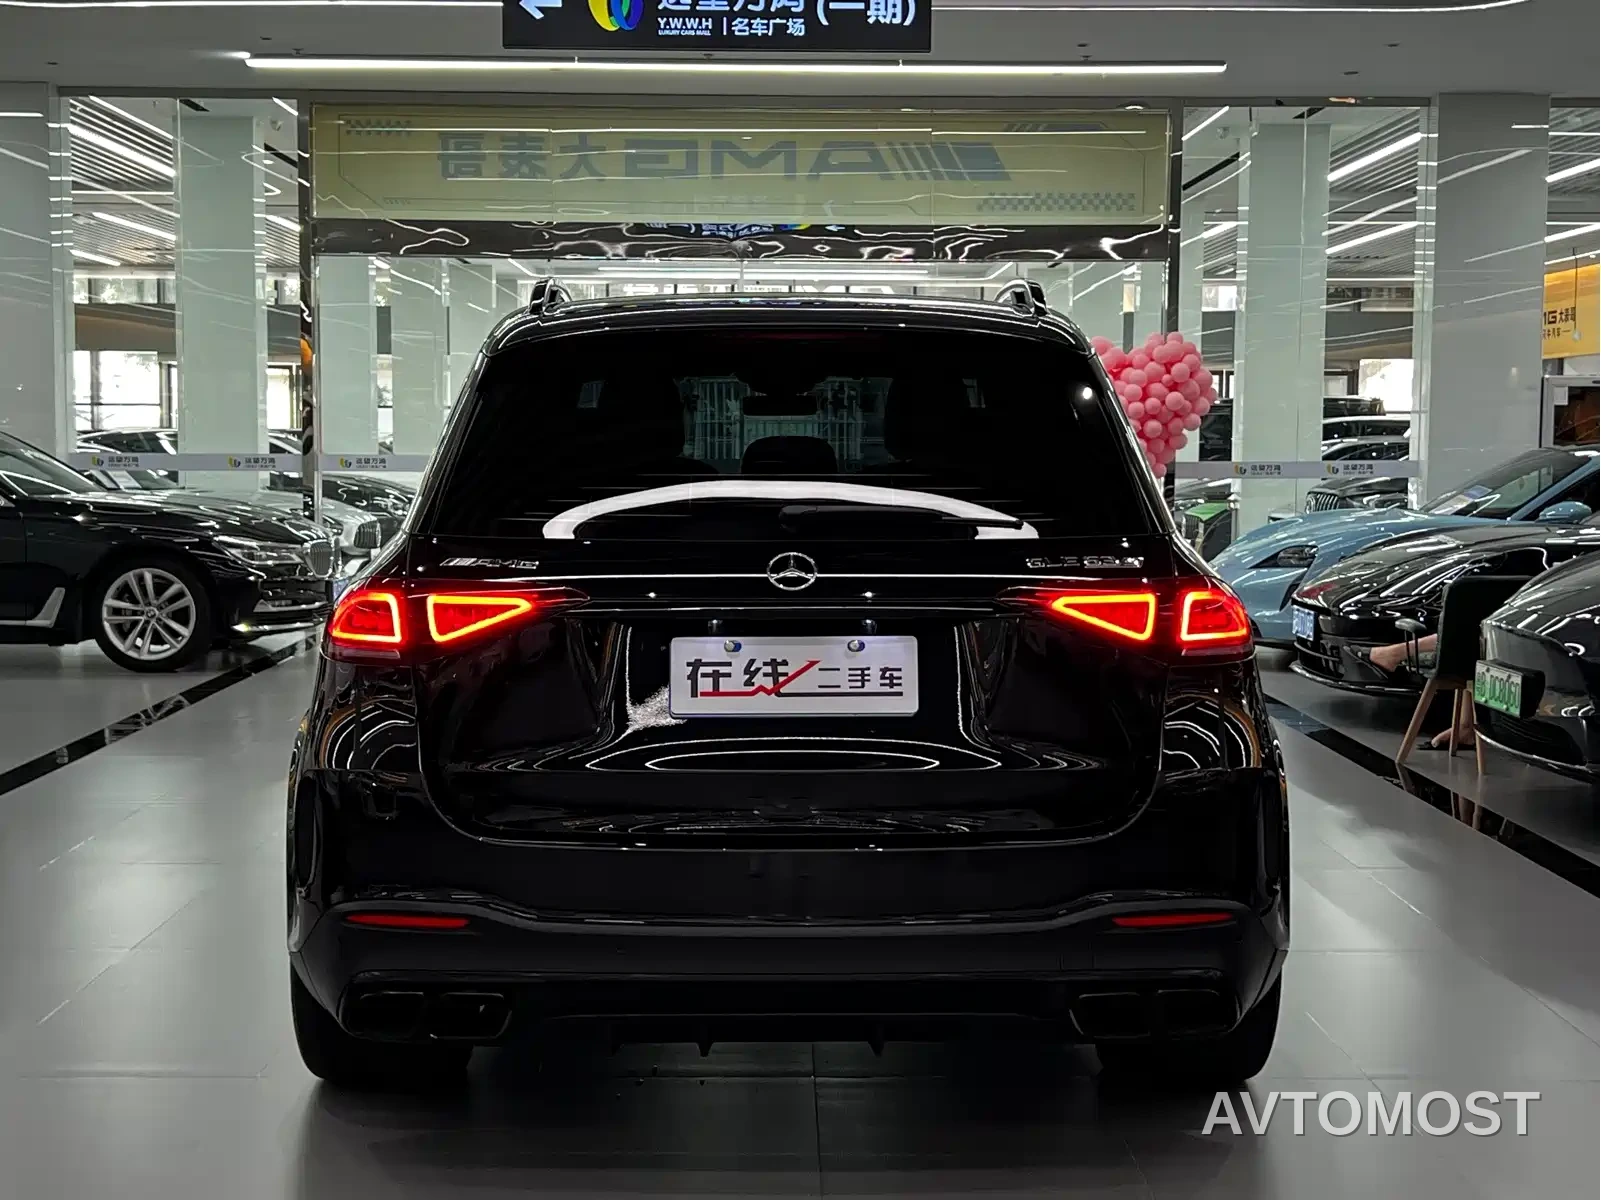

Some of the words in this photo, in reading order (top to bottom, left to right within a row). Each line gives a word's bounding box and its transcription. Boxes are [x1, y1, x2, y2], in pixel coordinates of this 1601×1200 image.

[657, 17, 713, 29] Y.W.W.H
[731, 18, 805, 36] 名车广场
[470, 558, 539, 569] AMG
[1025, 557, 1081, 568] GLE
[686, 658, 789, 698] 在线
[818, 667, 902, 689] 二手车
